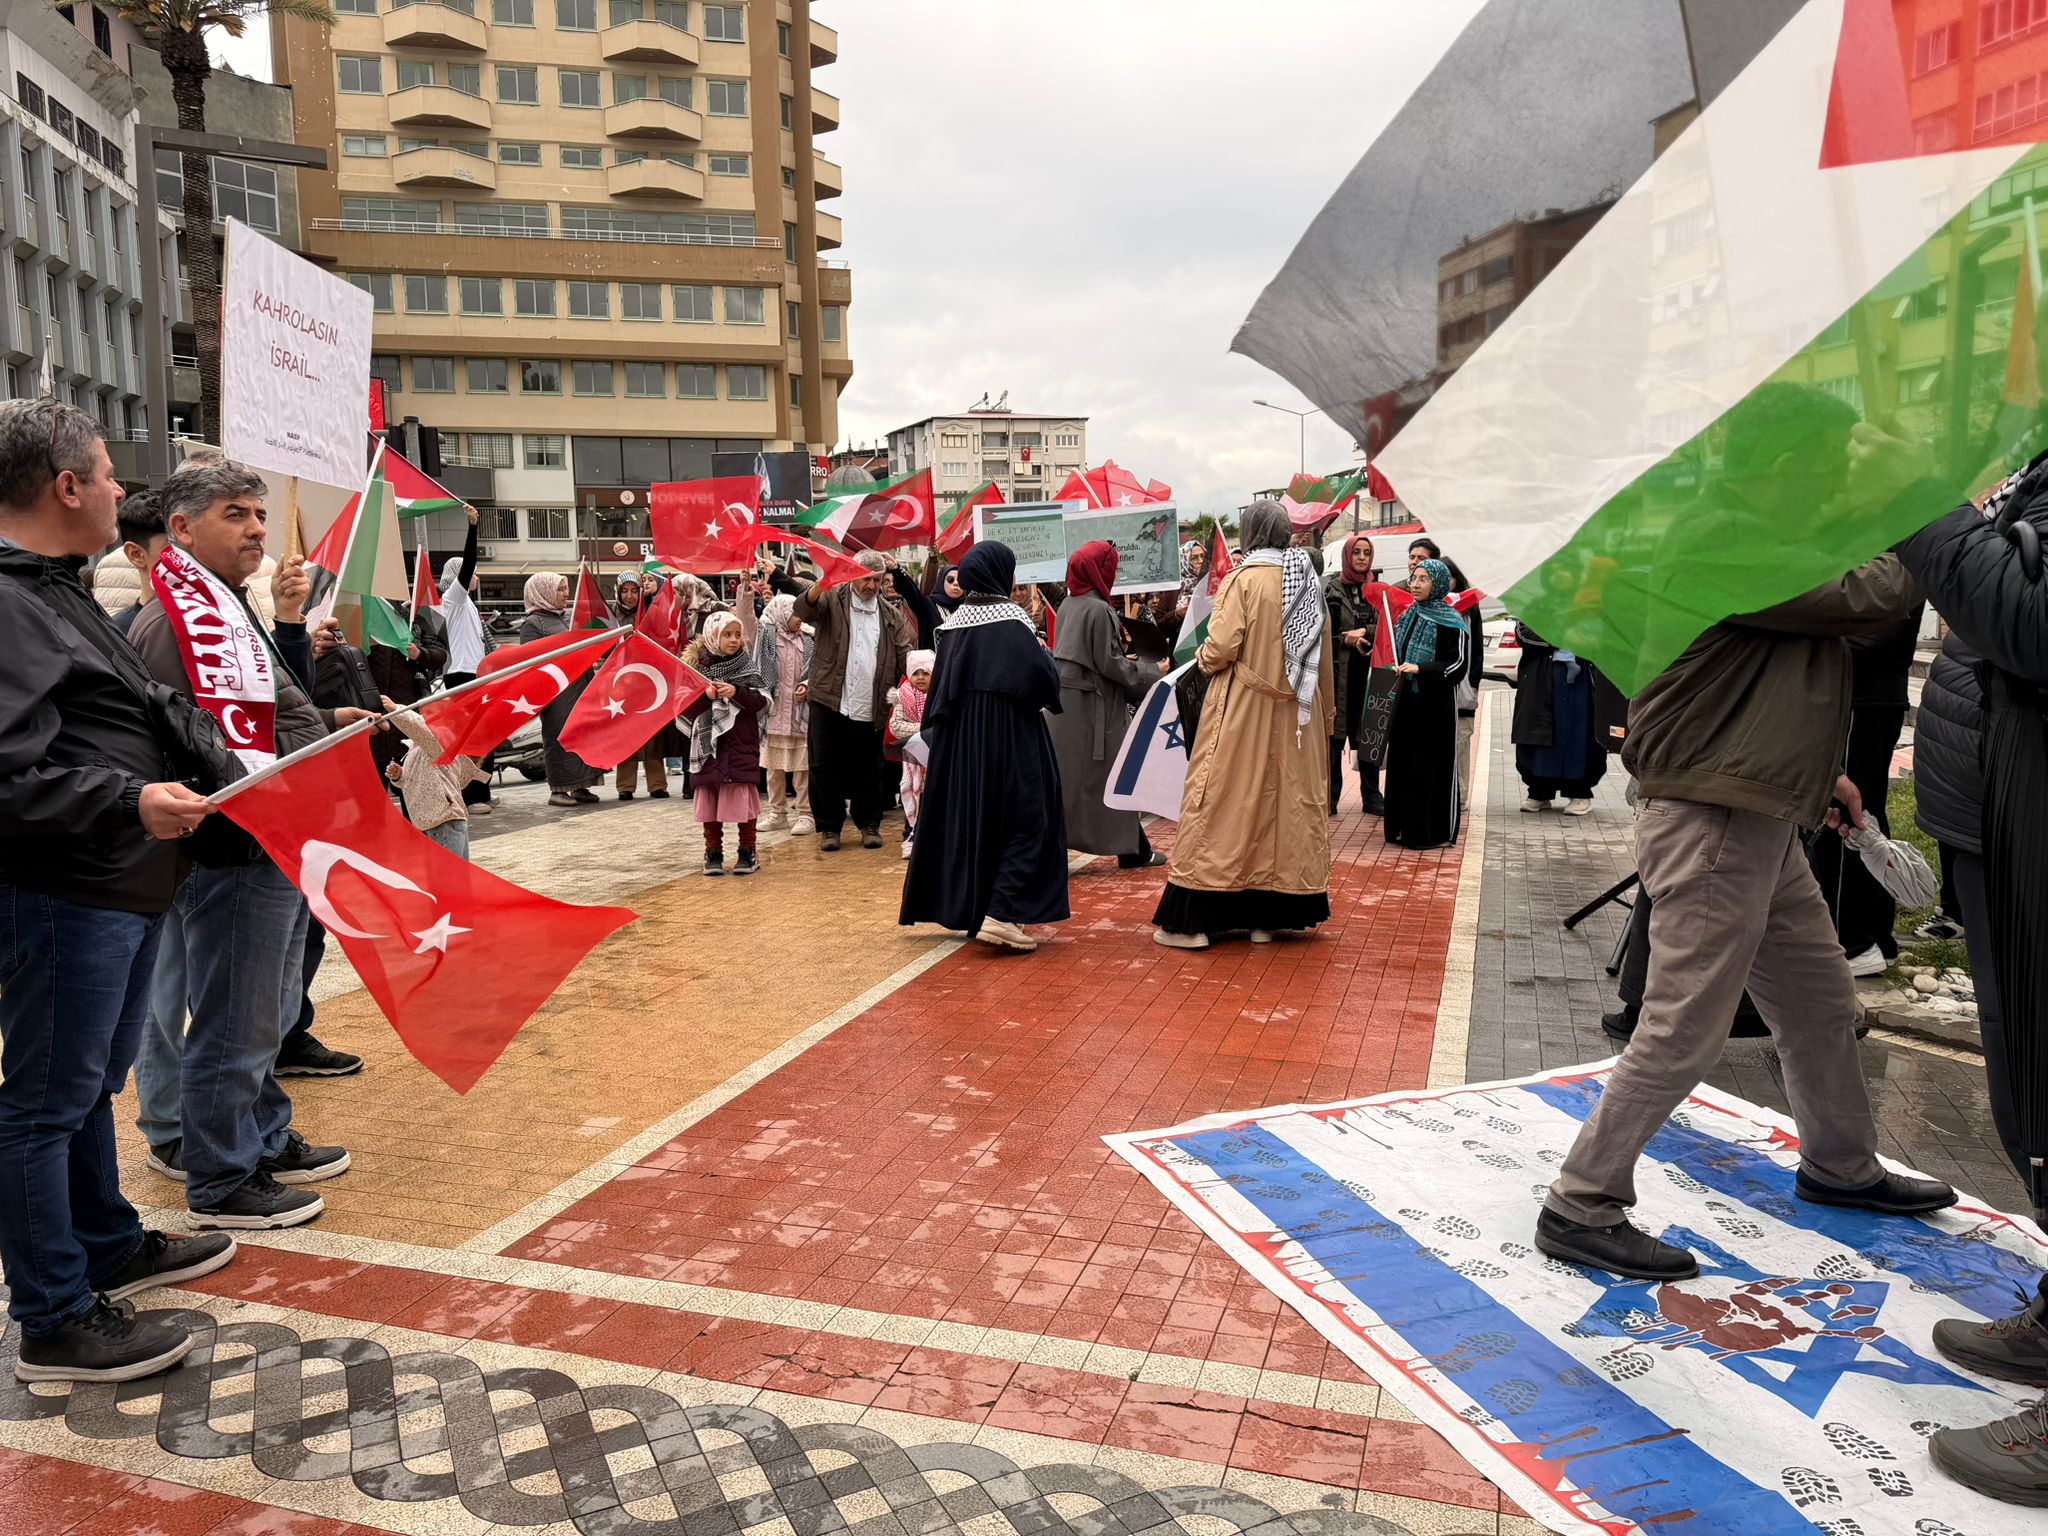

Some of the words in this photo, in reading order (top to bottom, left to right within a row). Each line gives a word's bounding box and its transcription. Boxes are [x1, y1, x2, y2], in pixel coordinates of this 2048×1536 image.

[253, 289, 338, 346] KAHROLASIN
[270, 340, 321, 382] İSRAİL...
[1367, 693, 1392, 713] BİZE
